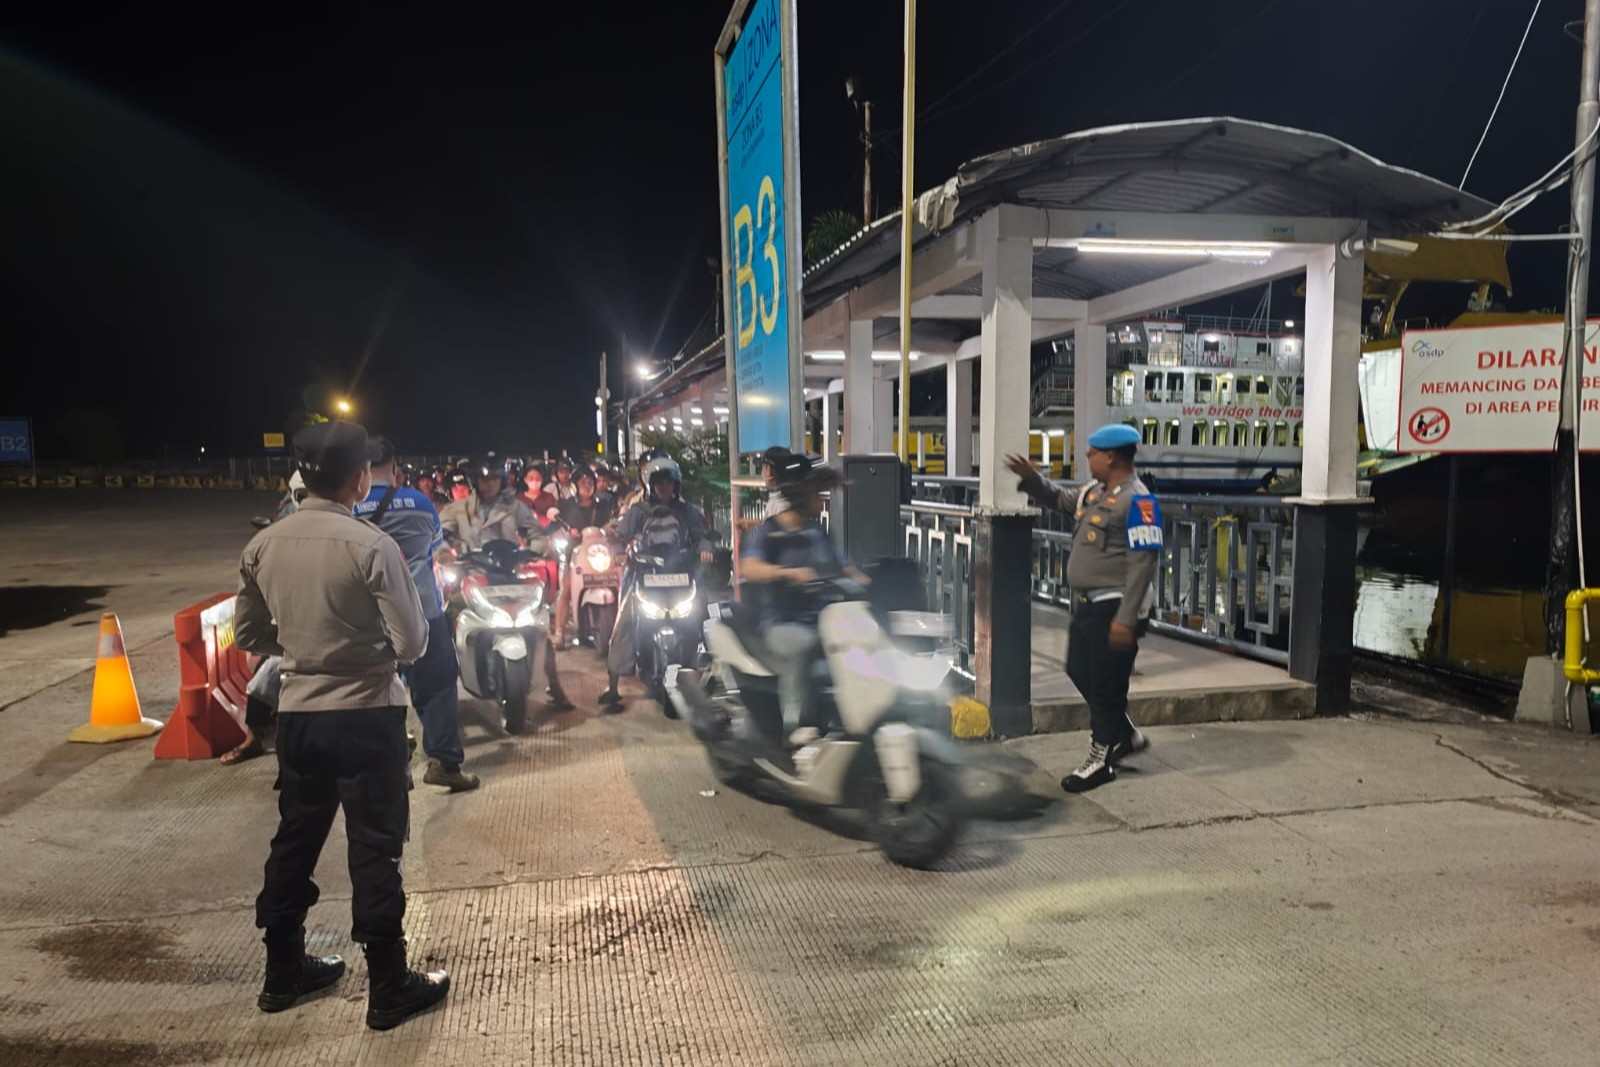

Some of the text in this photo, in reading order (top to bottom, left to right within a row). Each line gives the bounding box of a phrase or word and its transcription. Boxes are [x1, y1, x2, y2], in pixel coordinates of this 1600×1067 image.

[734, 176, 780, 349] B3
[1421, 379, 1526, 395] MEMANCING
[1182, 405, 1203, 416] we
[1208, 403, 1253, 418] bridge
[1258, 404, 1281, 417] the
[1465, 402, 1482, 414] DI
[1487, 400, 1532, 413] AREA
